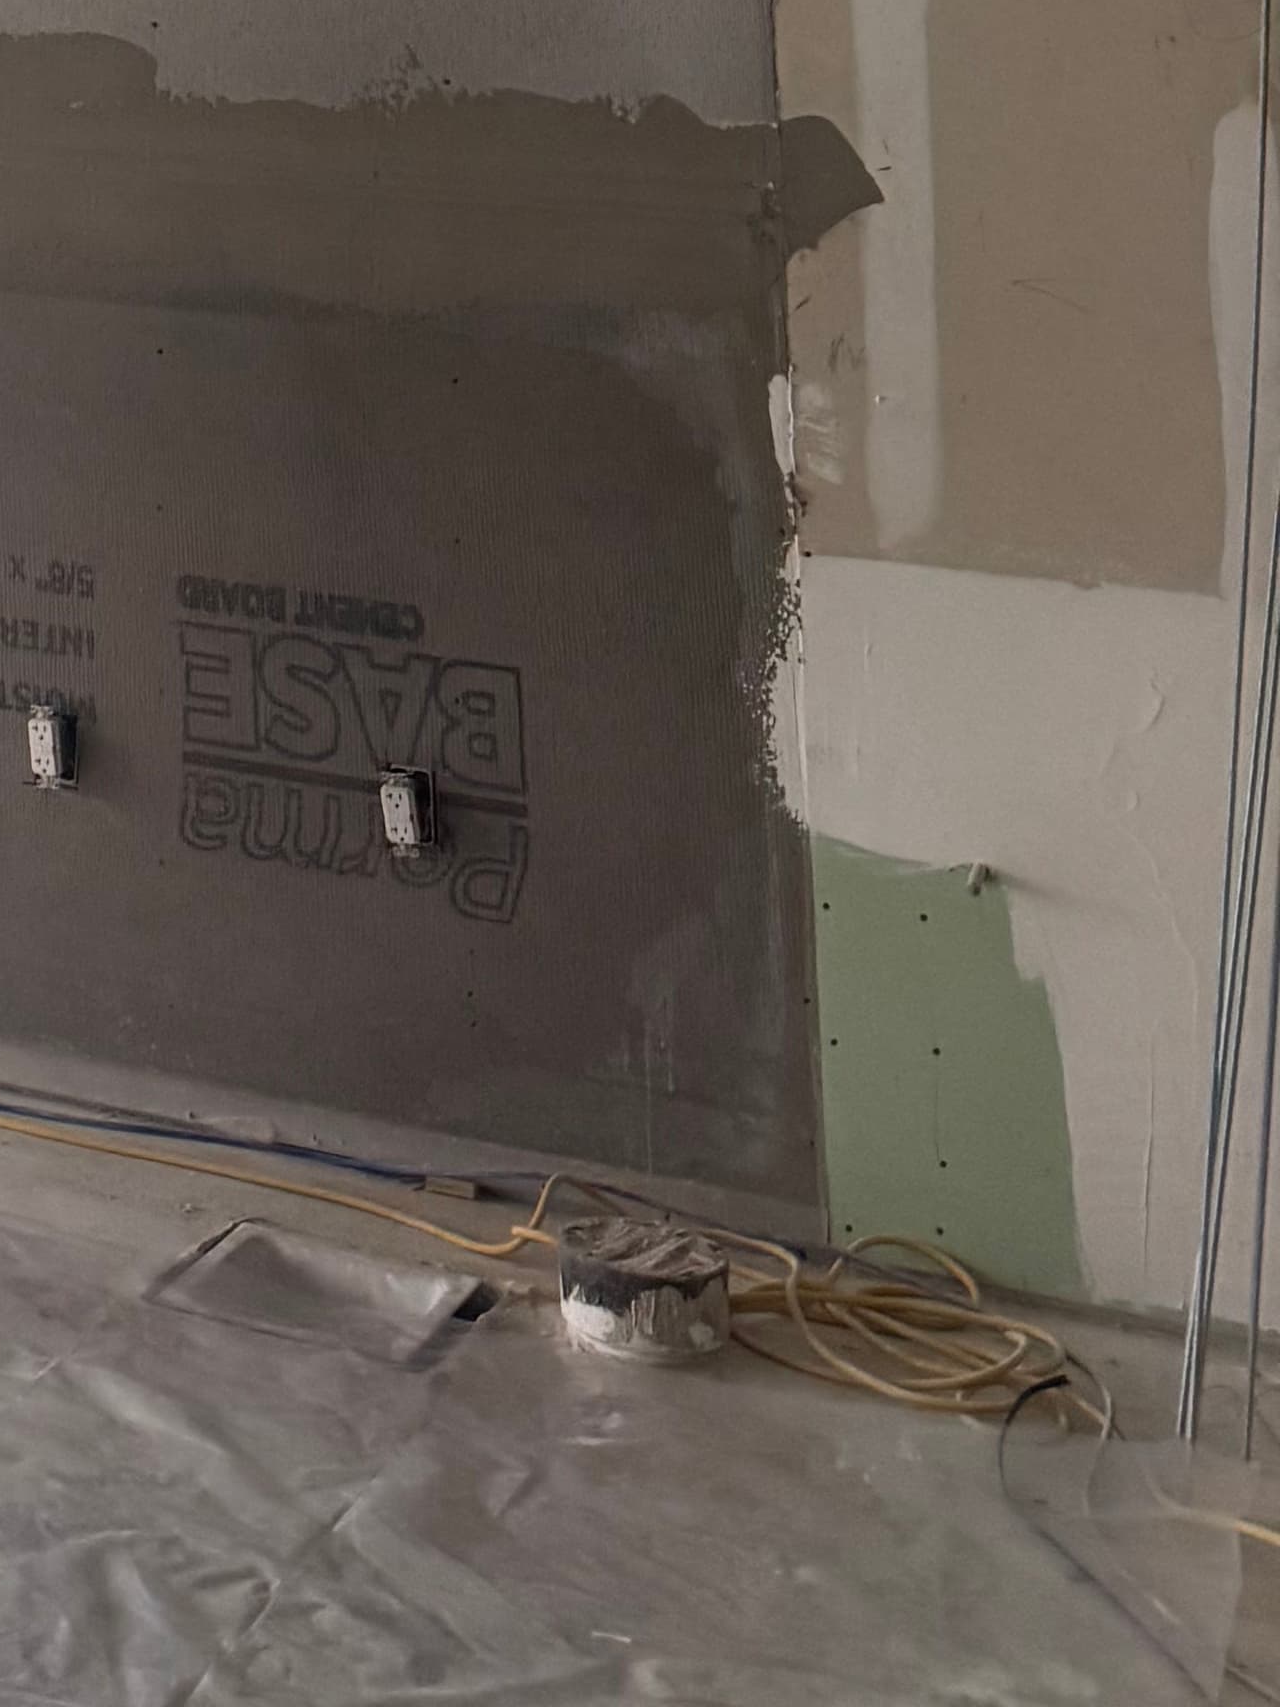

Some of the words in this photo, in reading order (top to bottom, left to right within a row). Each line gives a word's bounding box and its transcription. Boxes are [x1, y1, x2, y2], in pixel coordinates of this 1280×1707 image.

[177, 574, 288, 623] BOARD
[294, 589, 425, 642] CEMENT
[180, 620, 526, 793] BASE
